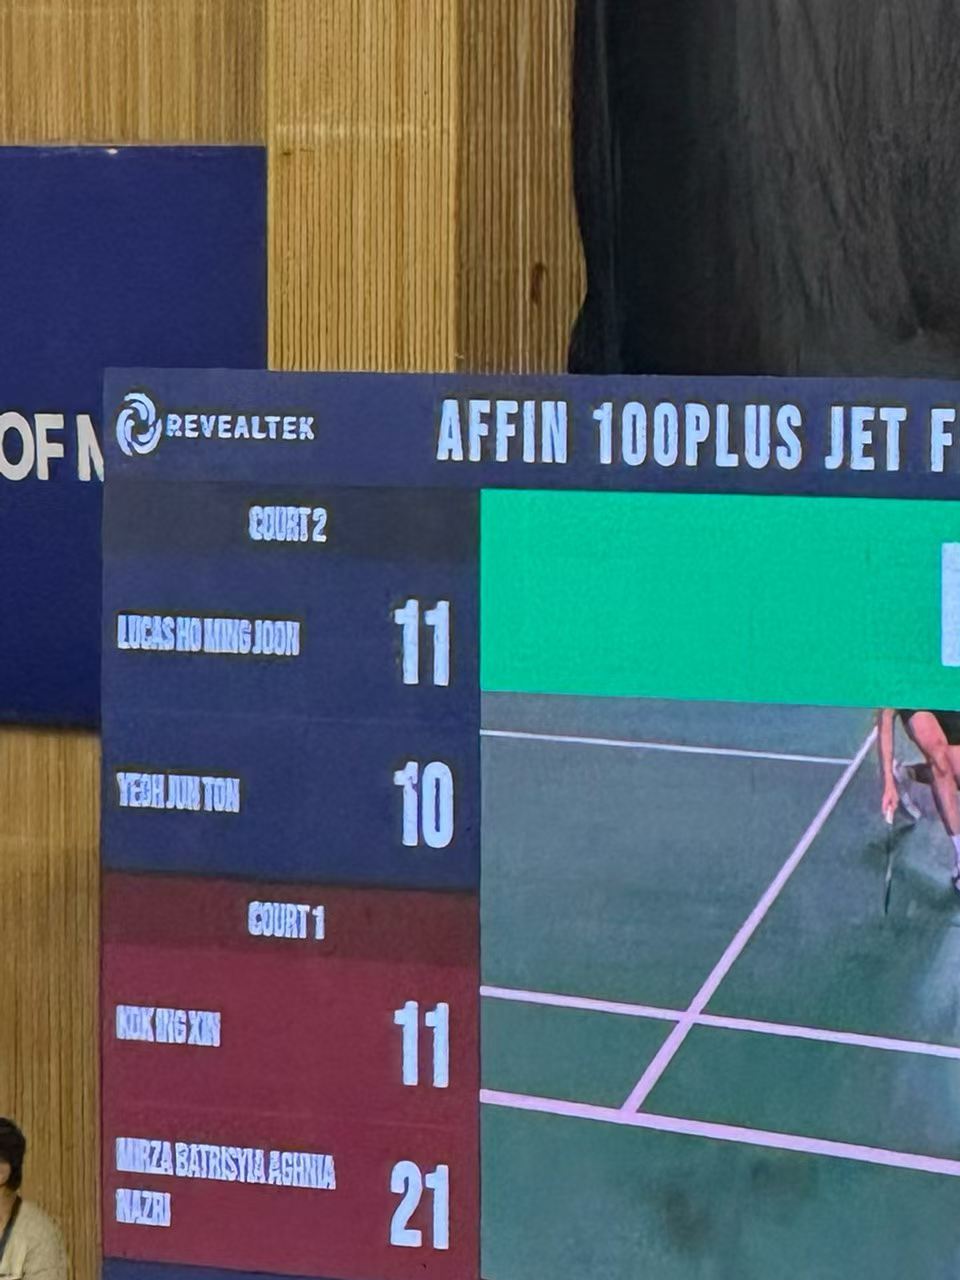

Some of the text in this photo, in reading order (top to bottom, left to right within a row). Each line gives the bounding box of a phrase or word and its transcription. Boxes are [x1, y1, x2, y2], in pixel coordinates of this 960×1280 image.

[0, 411, 64, 482] OF
[166, 413, 315, 440] REVEALTEK
[436, 399, 568, 465] AFFIN
[593, 402, 802, 470] 100PLUS
[824, 405, 907, 472] JET
[249, 506, 327, 543] COURT 2
[117, 614, 175, 650] LUCAS
[176, 616, 201, 652] HO
[252, 620, 300, 656] JOON
[394, 599, 450, 687] 11
[394, 761, 454, 849] 10
[248, 901, 325, 940] COURT 1
[394, 1001, 449, 1088] 11
[390, 1161, 449, 1250] 21
